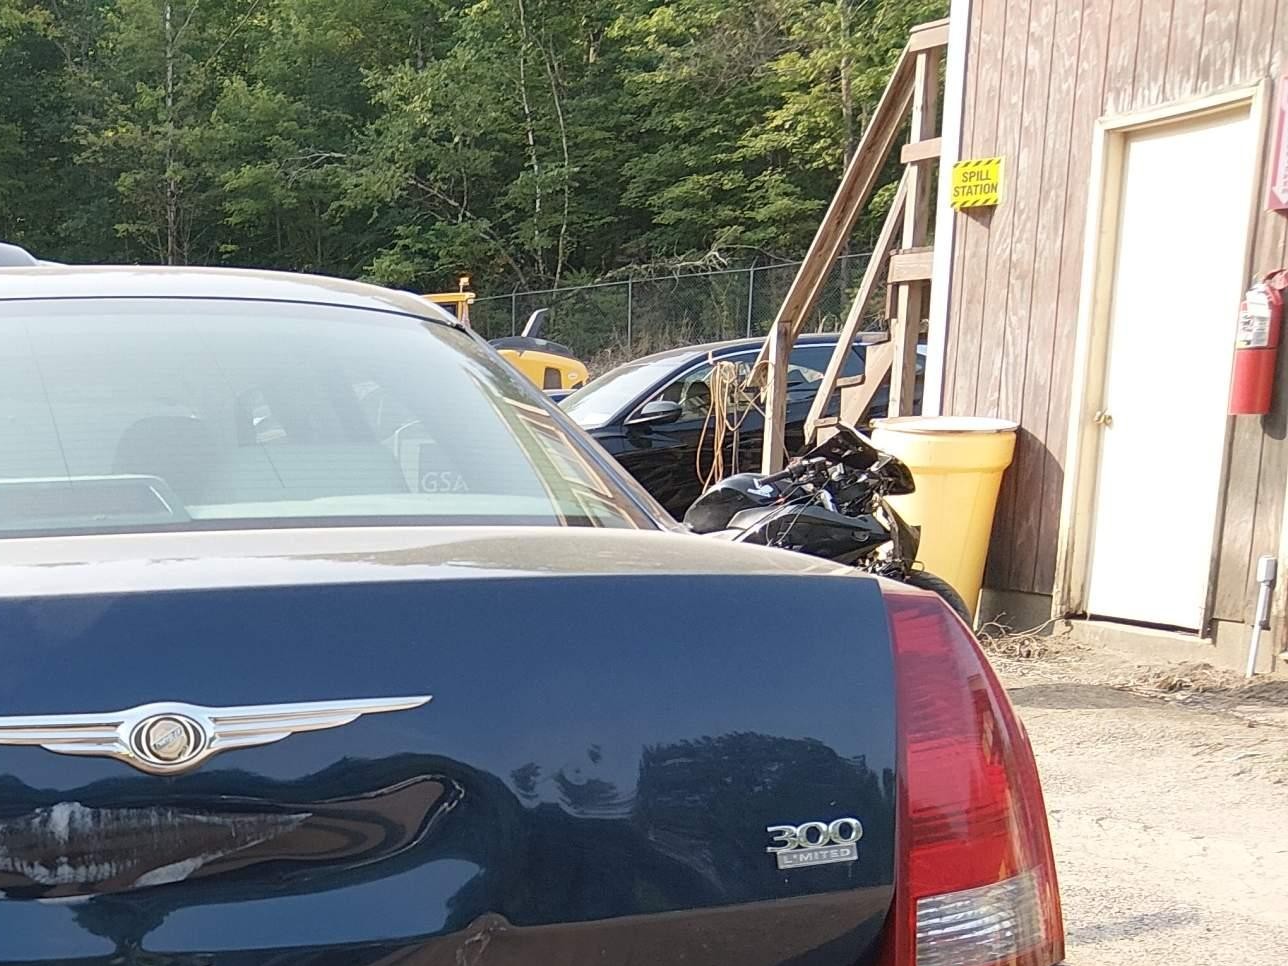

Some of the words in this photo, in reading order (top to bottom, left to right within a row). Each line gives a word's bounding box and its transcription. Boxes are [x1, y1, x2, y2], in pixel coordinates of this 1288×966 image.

[961, 170, 991, 183] SPILL
[953, 183, 998, 197] STATION
[767, 818, 862, 852] 300
[783, 848, 851, 864] LIMITED
